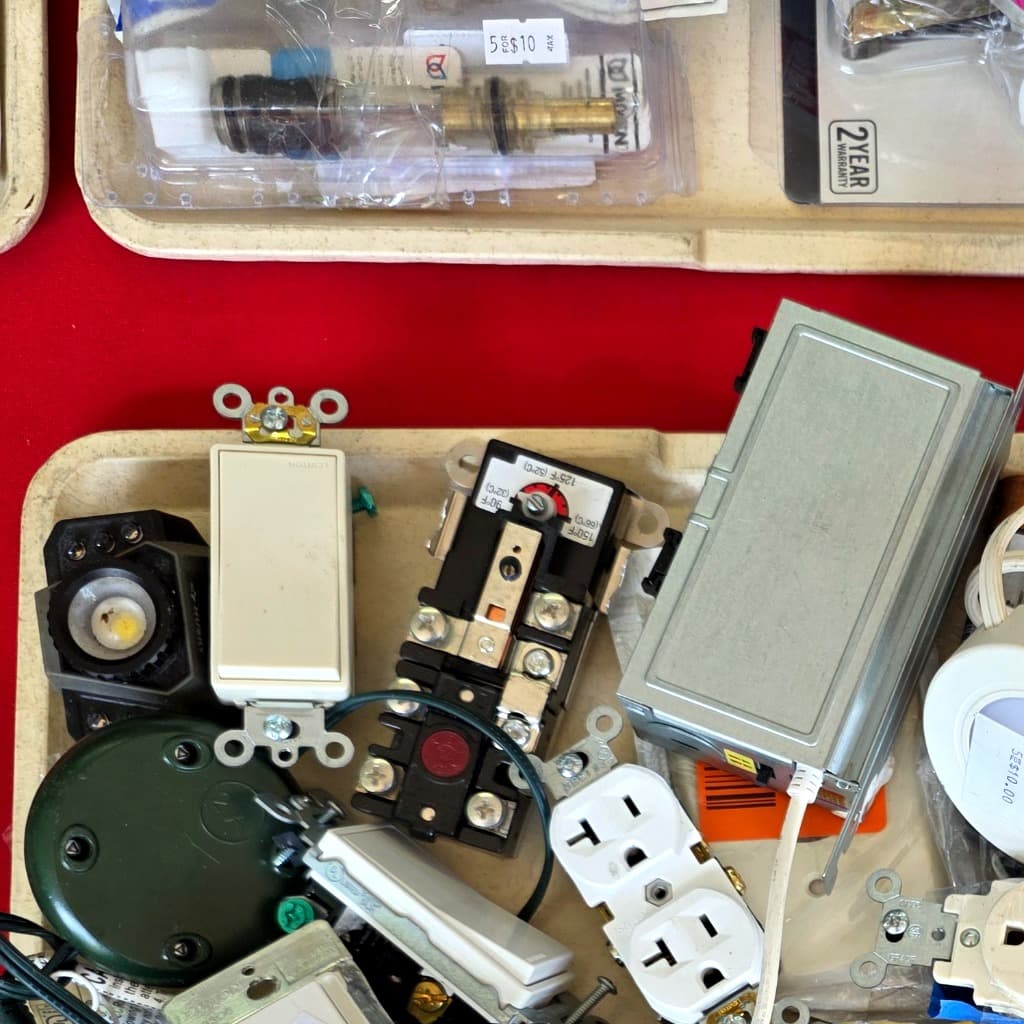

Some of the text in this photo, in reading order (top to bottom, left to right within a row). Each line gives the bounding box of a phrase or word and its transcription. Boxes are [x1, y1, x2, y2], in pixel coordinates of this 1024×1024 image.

[490, 34, 536, 54] 5 FOR $10
[836, 126, 870, 188] 2 YEAR
[837, 143, 849, 188] WARRANTY
[523, 461, 576, 487] 125°F (52°C)
[486, 482, 510, 497] (32°C)
[568, 526, 594, 542] 150°F
[1011, 748, 1023, 759] 5
[1001, 762, 1020, 805] $10.00
